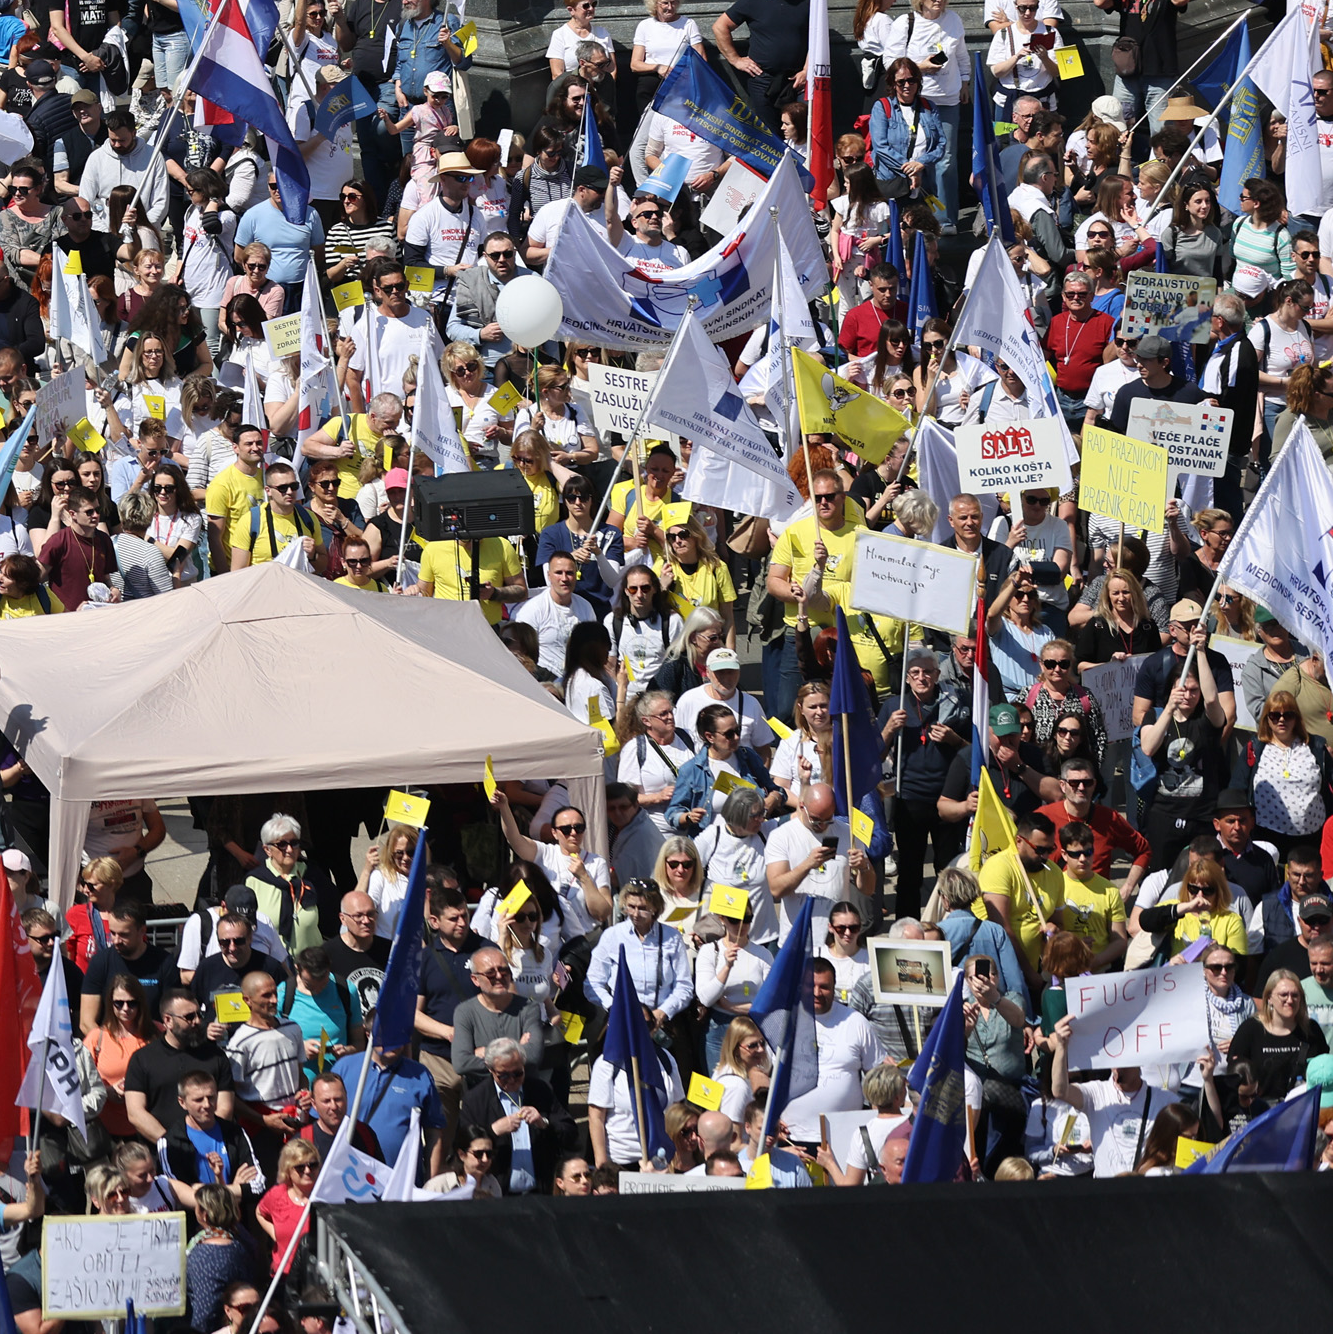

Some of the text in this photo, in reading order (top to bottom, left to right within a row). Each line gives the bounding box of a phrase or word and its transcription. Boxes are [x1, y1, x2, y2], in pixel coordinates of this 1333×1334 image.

[80, 10, 107, 22] MATH
[1134, 276, 1200, 291] ZDRAVSTVO
[1133, 289, 1184, 302] JE JAVNO
[1131, 301, 1173, 314] DOBRO!
[607, 318, 662, 339] HRVATSKI
[604, 372, 649, 393] SESTRE
[692, 412, 730, 436] HRVATSKI
[981, 430, 1035, 460] SALE
[1085, 430, 1105, 453] RAD
[1151, 430, 1221, 448] VEĆE PLAĆE
[1169, 444, 1224, 461] OSTANAK
[969, 461, 1053, 477] KOLIKO KOŠTA
[980, 472, 1043, 488] ZDRAVLJE?
[1107, 464, 1139, 496] NIJE
[1127, 498, 1157, 527] RADA
[871, 570, 926, 594] motivacija
[1079, 972, 1177, 1014] FUCHS
[1103, 1022, 1172, 1058] OFF
[55, 1222, 83, 1252] AKO
